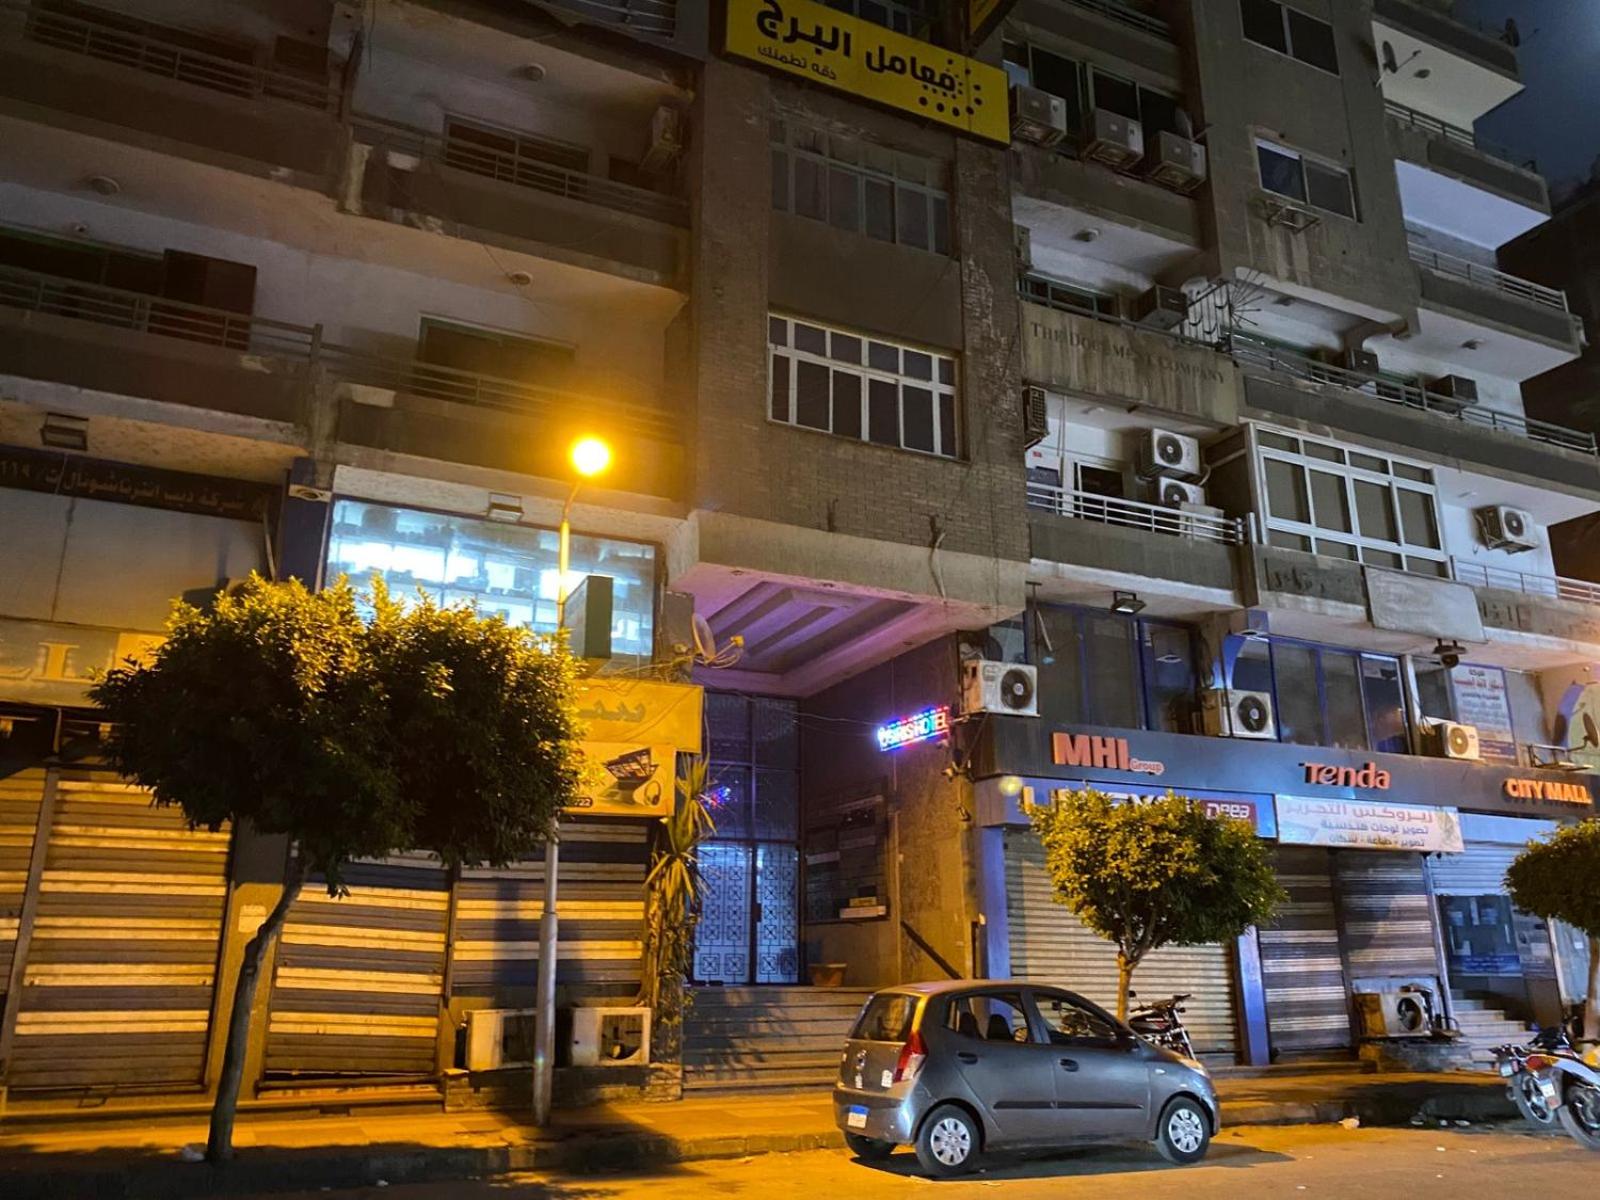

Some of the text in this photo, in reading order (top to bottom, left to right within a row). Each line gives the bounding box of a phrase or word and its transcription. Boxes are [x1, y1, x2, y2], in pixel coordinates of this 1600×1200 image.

[757, 0, 956, 92] معامل البرج
[1052, 732, 1130, 770] MHI
[1131, 760, 1163, 774] Group
[1304, 761, 1391, 789] Tenda
[1506, 778, 1593, 804] CITY MALL
